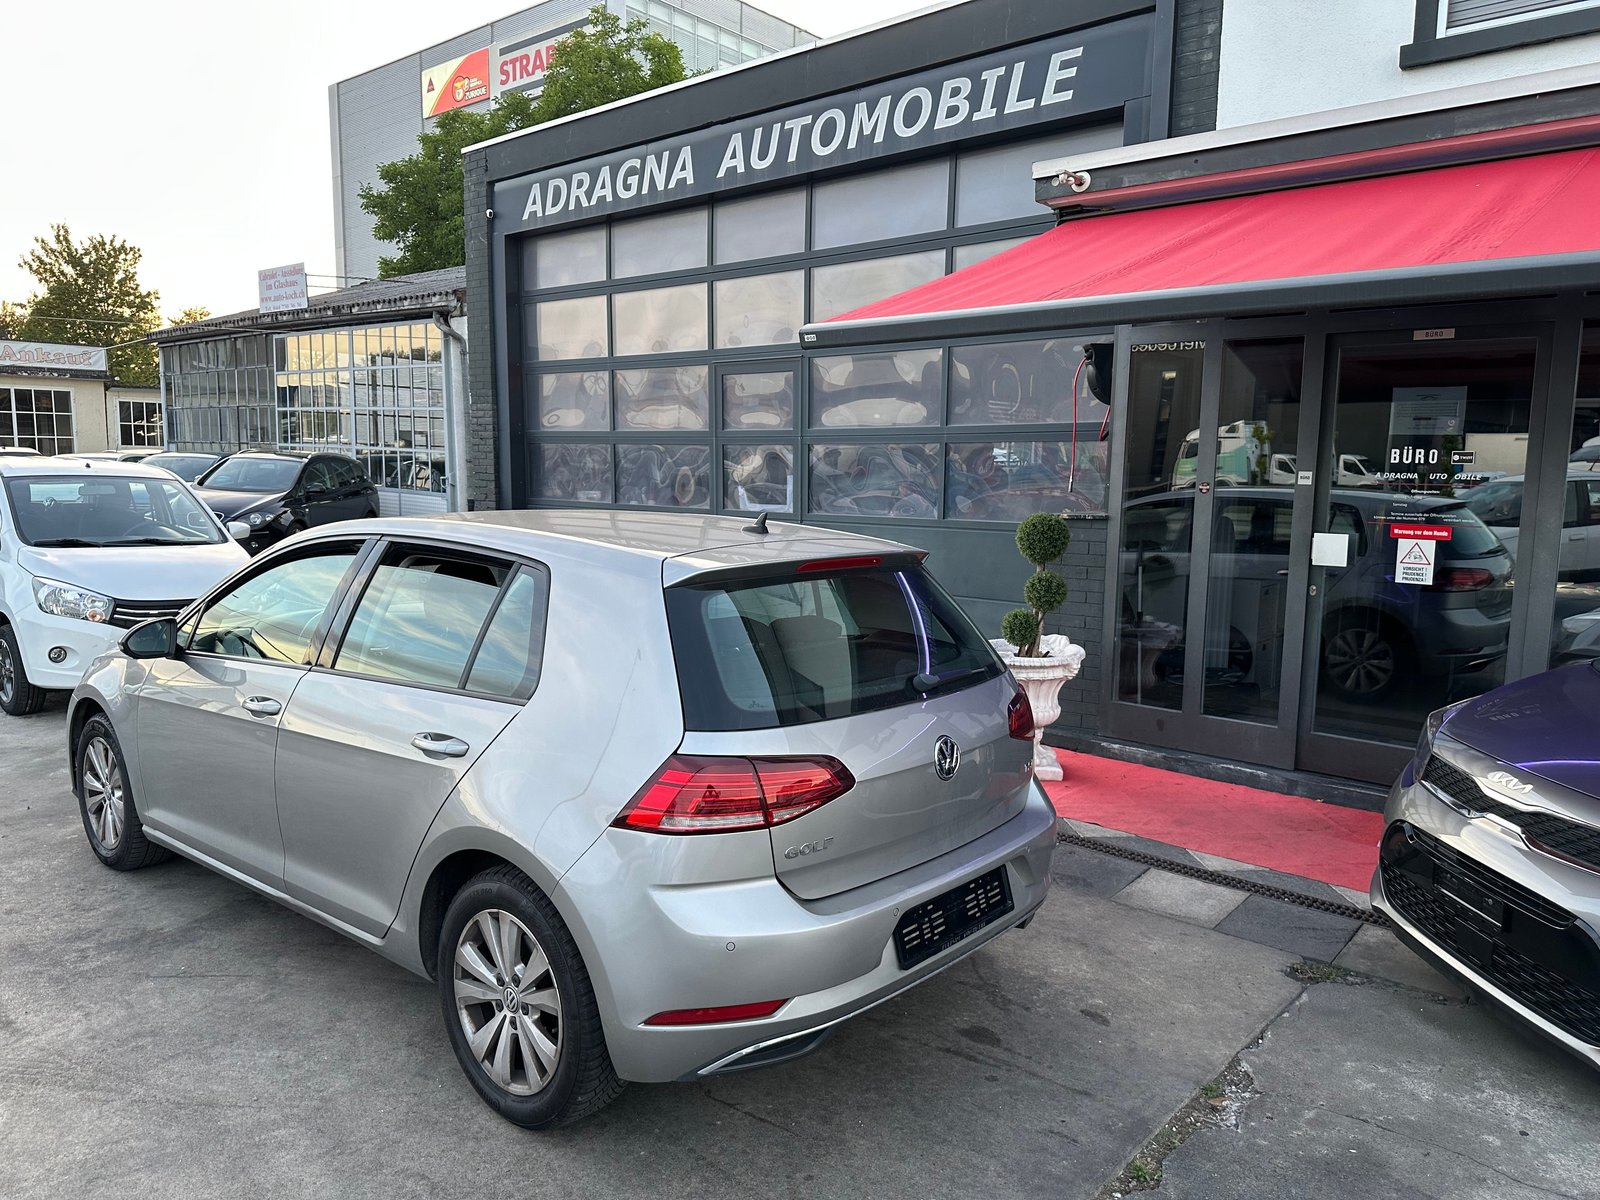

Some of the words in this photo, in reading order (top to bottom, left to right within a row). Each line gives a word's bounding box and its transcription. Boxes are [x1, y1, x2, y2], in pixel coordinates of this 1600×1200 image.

[499, 44, 557, 86] STRAB
[522, 146, 694, 221] ADRAGNA
[717, 46, 1084, 179] AUTOMOBILE
[1390, 446, 1438, 464] BÜRO
[784, 836, 834, 859] GOLF
